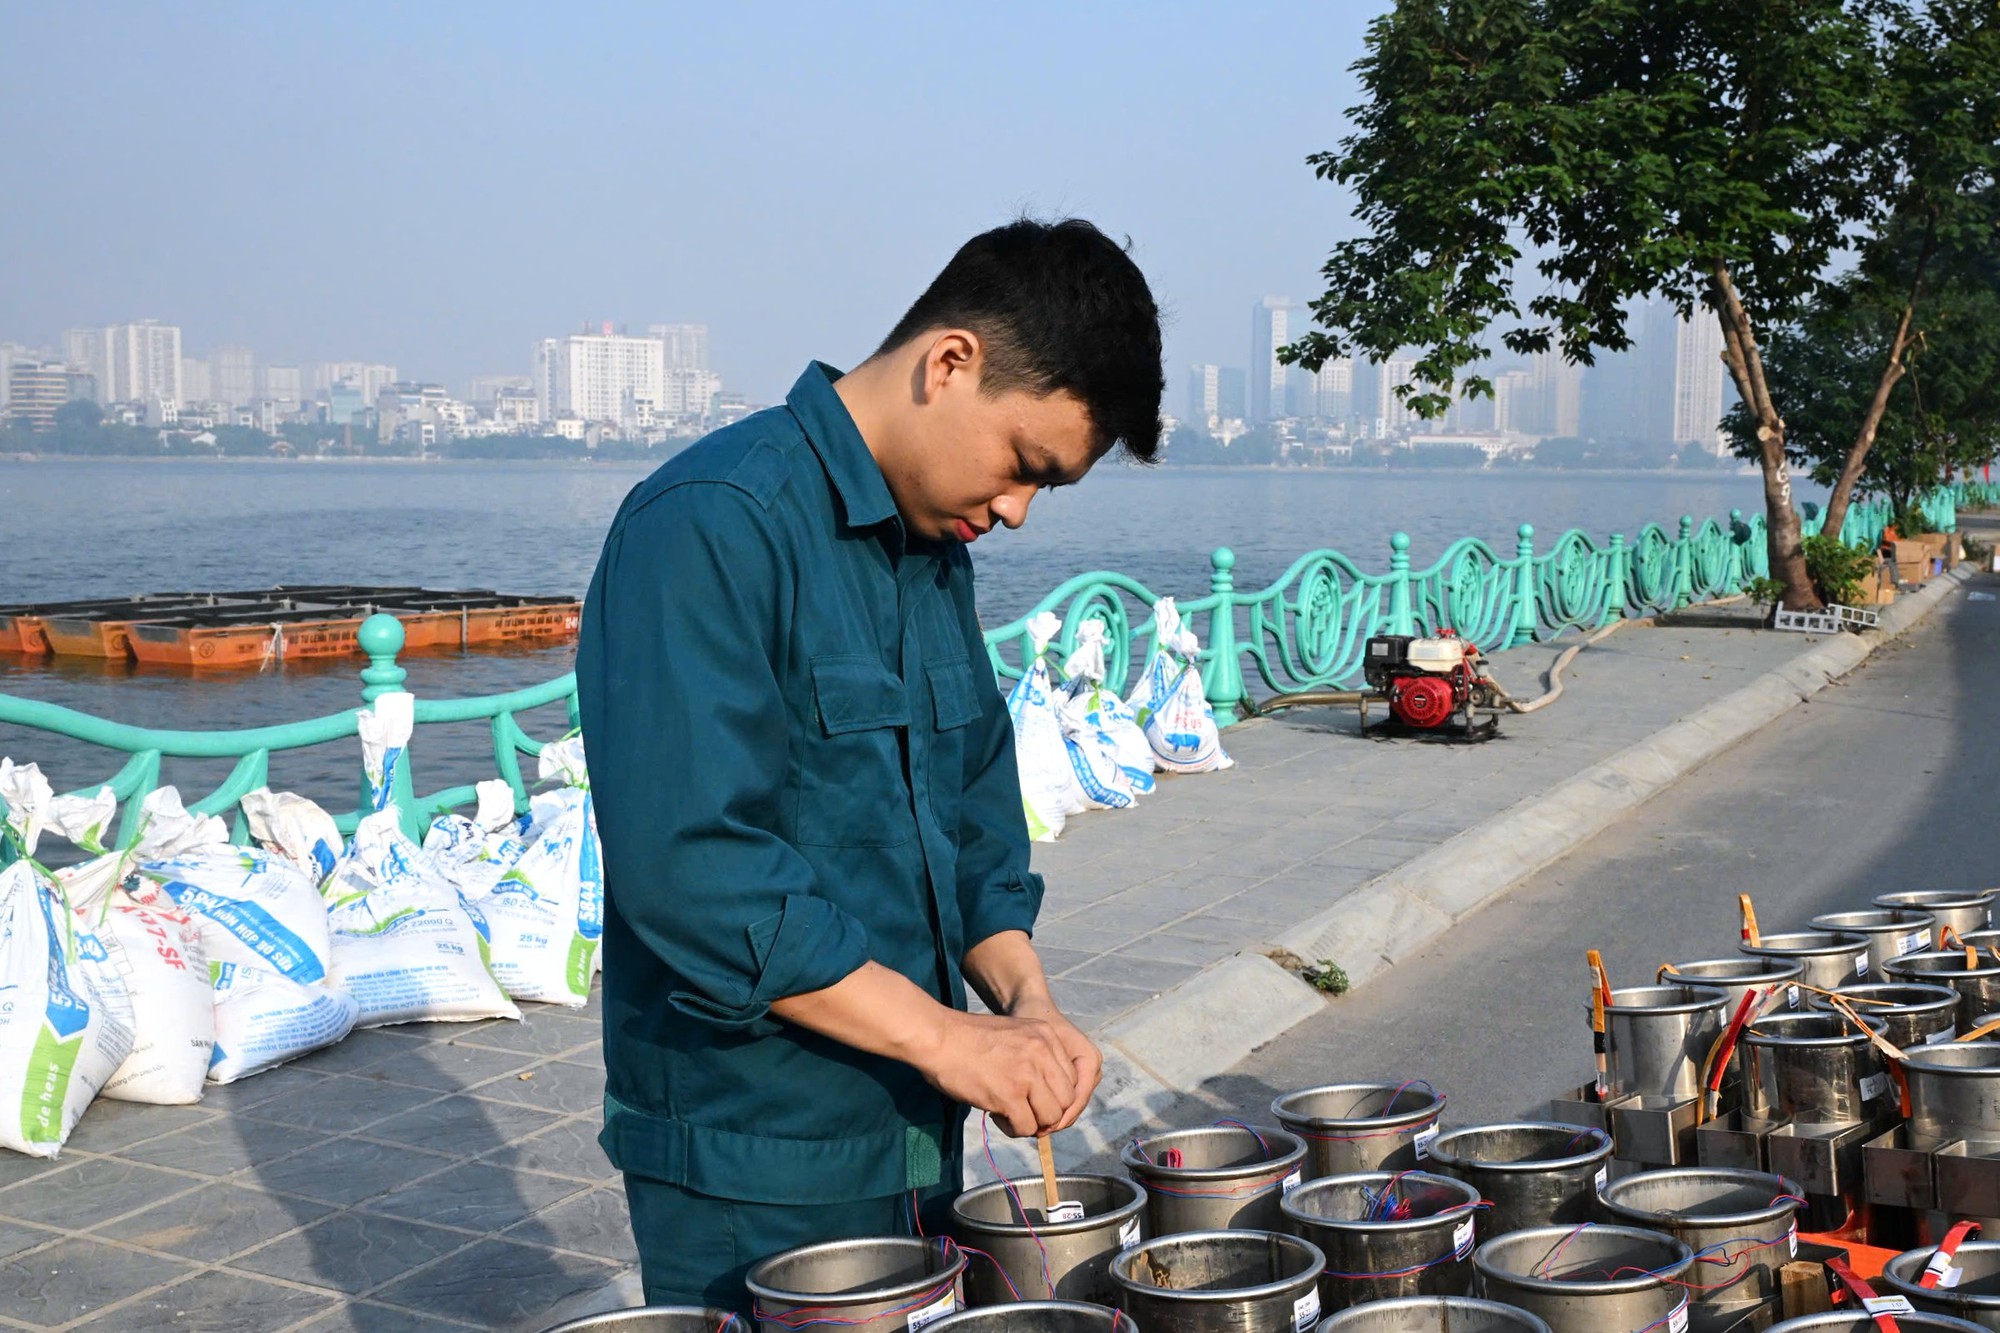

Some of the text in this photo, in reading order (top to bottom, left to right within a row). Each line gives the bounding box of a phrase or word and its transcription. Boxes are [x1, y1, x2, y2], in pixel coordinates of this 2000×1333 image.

[519, 934, 548, 945] 25 kg
[436, 942, 450, 950] 25
[36, 1063, 61, 1128] de heus
